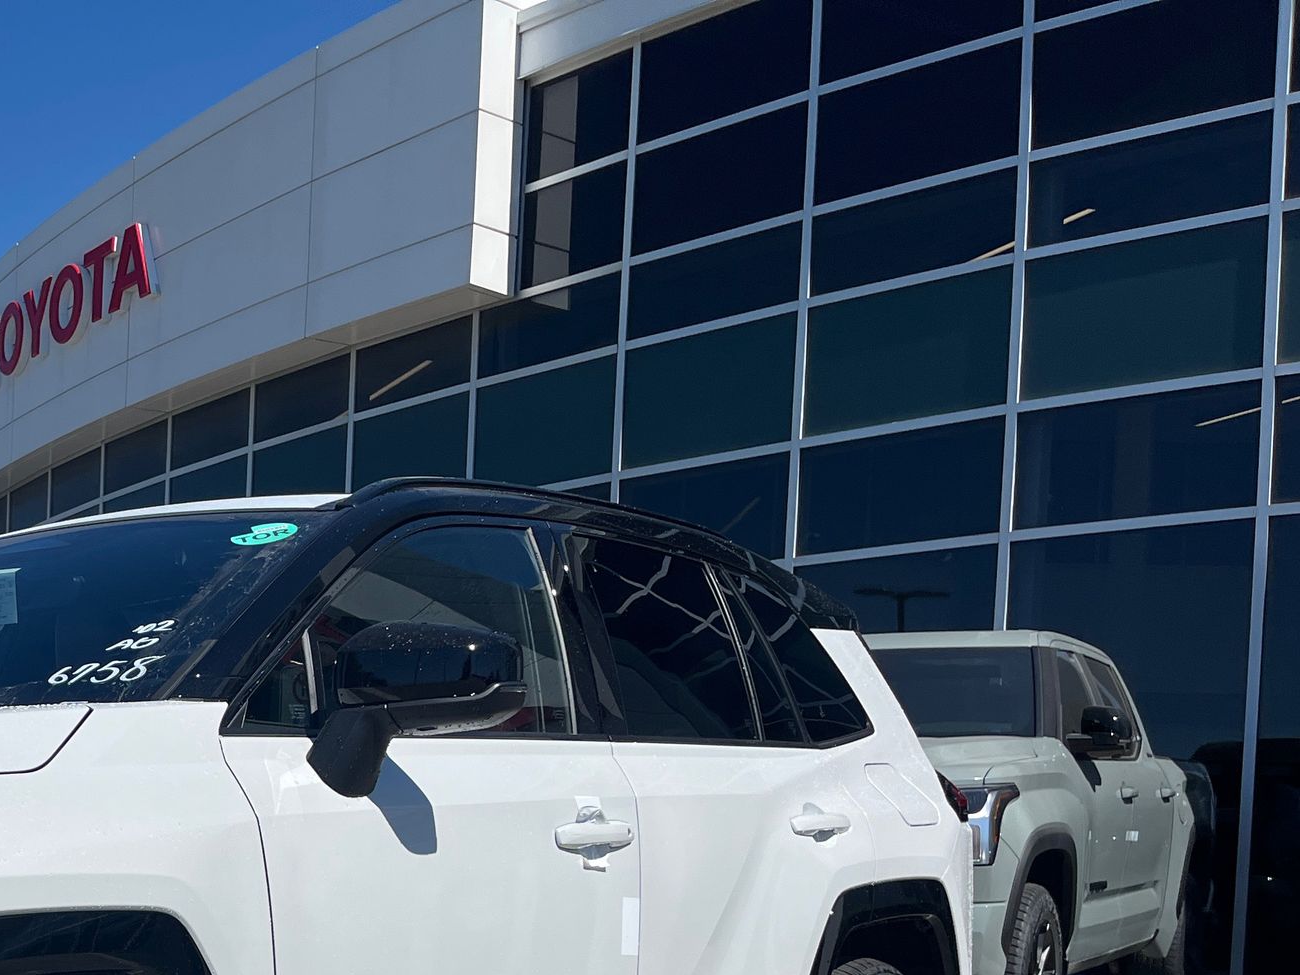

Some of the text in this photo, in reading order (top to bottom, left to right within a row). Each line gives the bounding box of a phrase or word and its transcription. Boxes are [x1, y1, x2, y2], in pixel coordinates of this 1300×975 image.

[235, 528, 290, 543] TOR
[132, 619, 175, 634] 102
[47, 654, 167, 685] 6758
